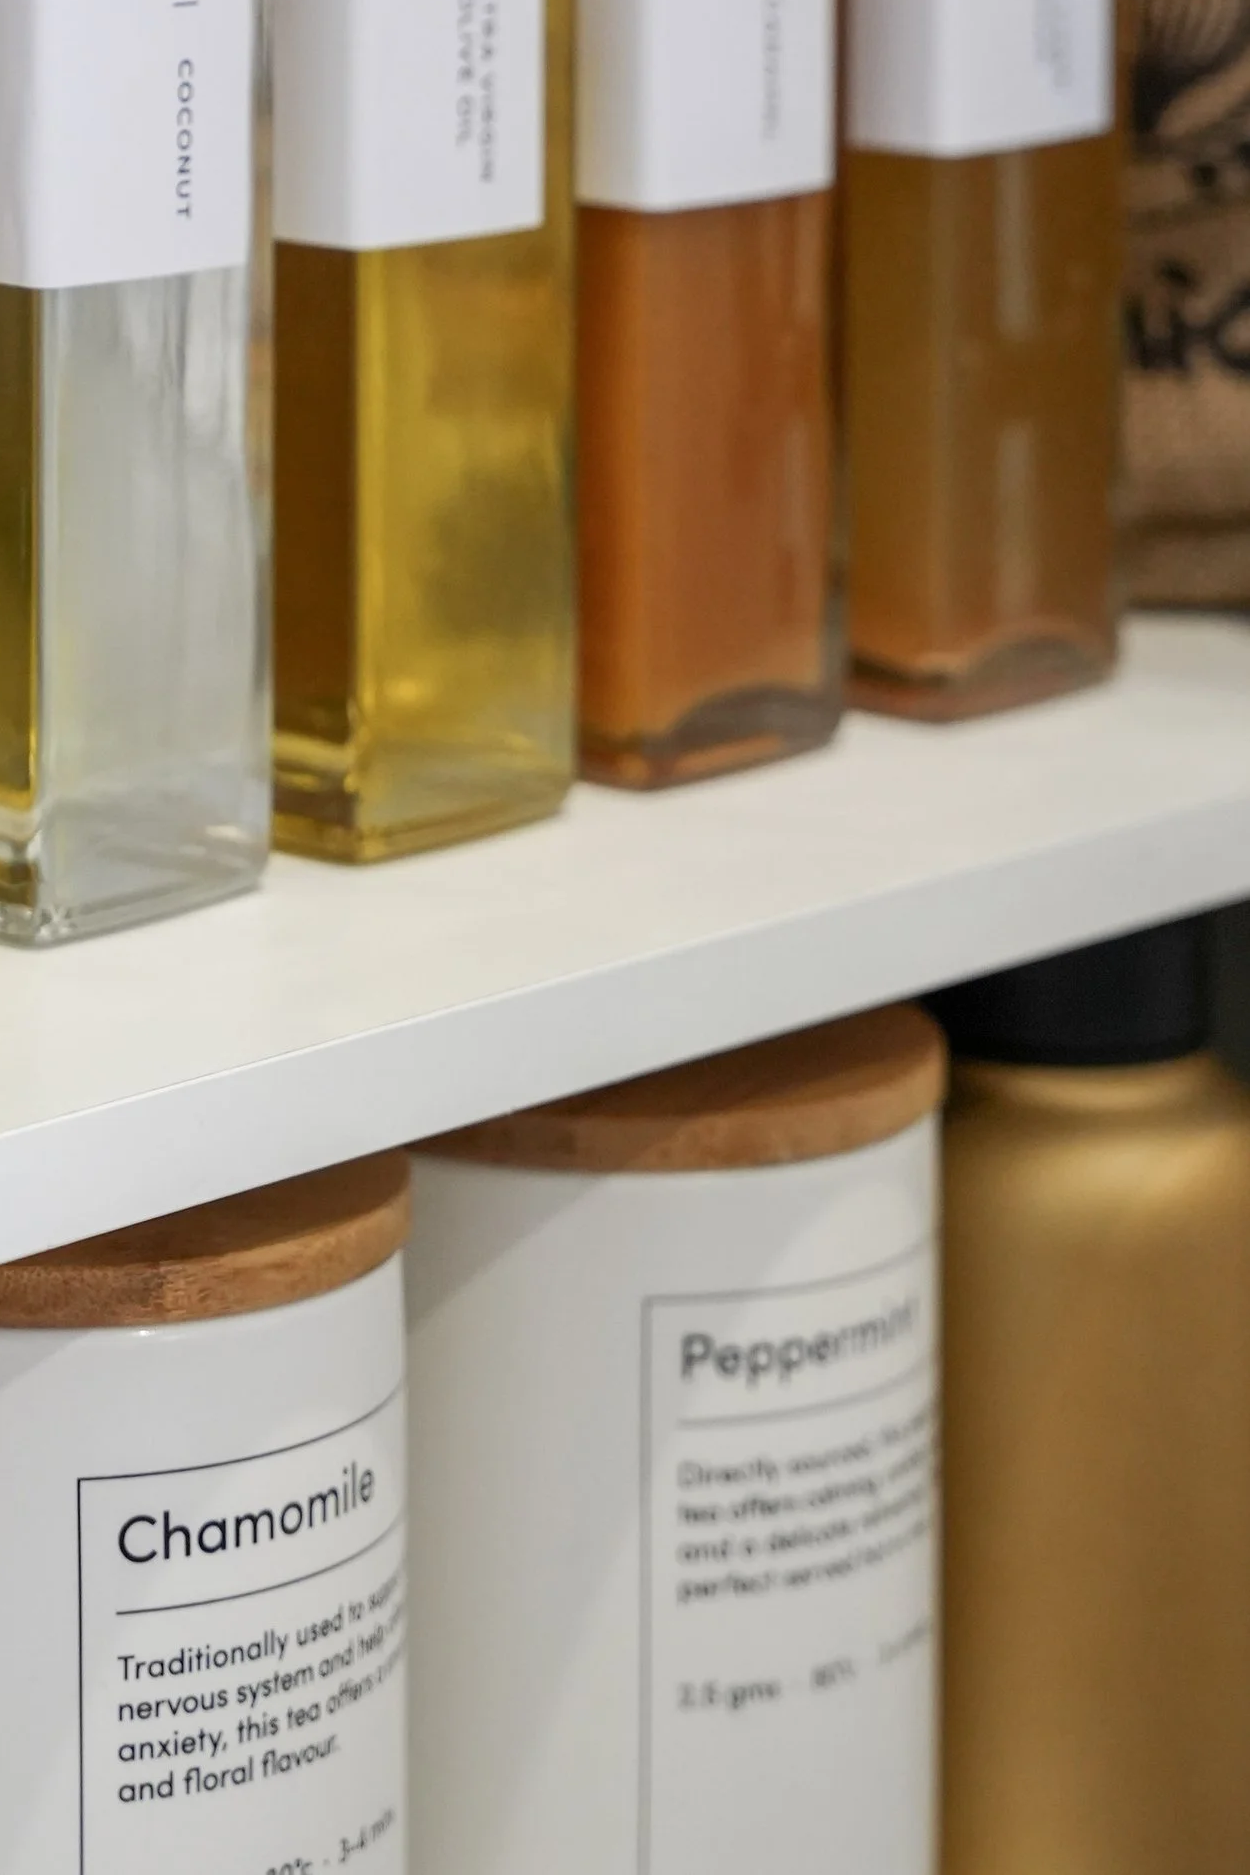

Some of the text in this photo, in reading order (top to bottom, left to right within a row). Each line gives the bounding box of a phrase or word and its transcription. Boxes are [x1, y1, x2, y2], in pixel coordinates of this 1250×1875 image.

[175, 57, 195, 220] COCONUT
[118, 1460, 376, 1563] Chamomile
[118, 1628, 289, 1681] Traditionally
[296, 1601, 343, 1648] used
[118, 1688, 228, 1723] nervous
[236, 1665, 316, 1708] system
[318, 1646, 354, 1679] and
[118, 1728, 229, 1763] anxiety,
[237, 1712, 280, 1746] this
[287, 1700, 322, 1728] tea
[118, 1770, 174, 1803] and
[184, 1755, 254, 1796] floral
